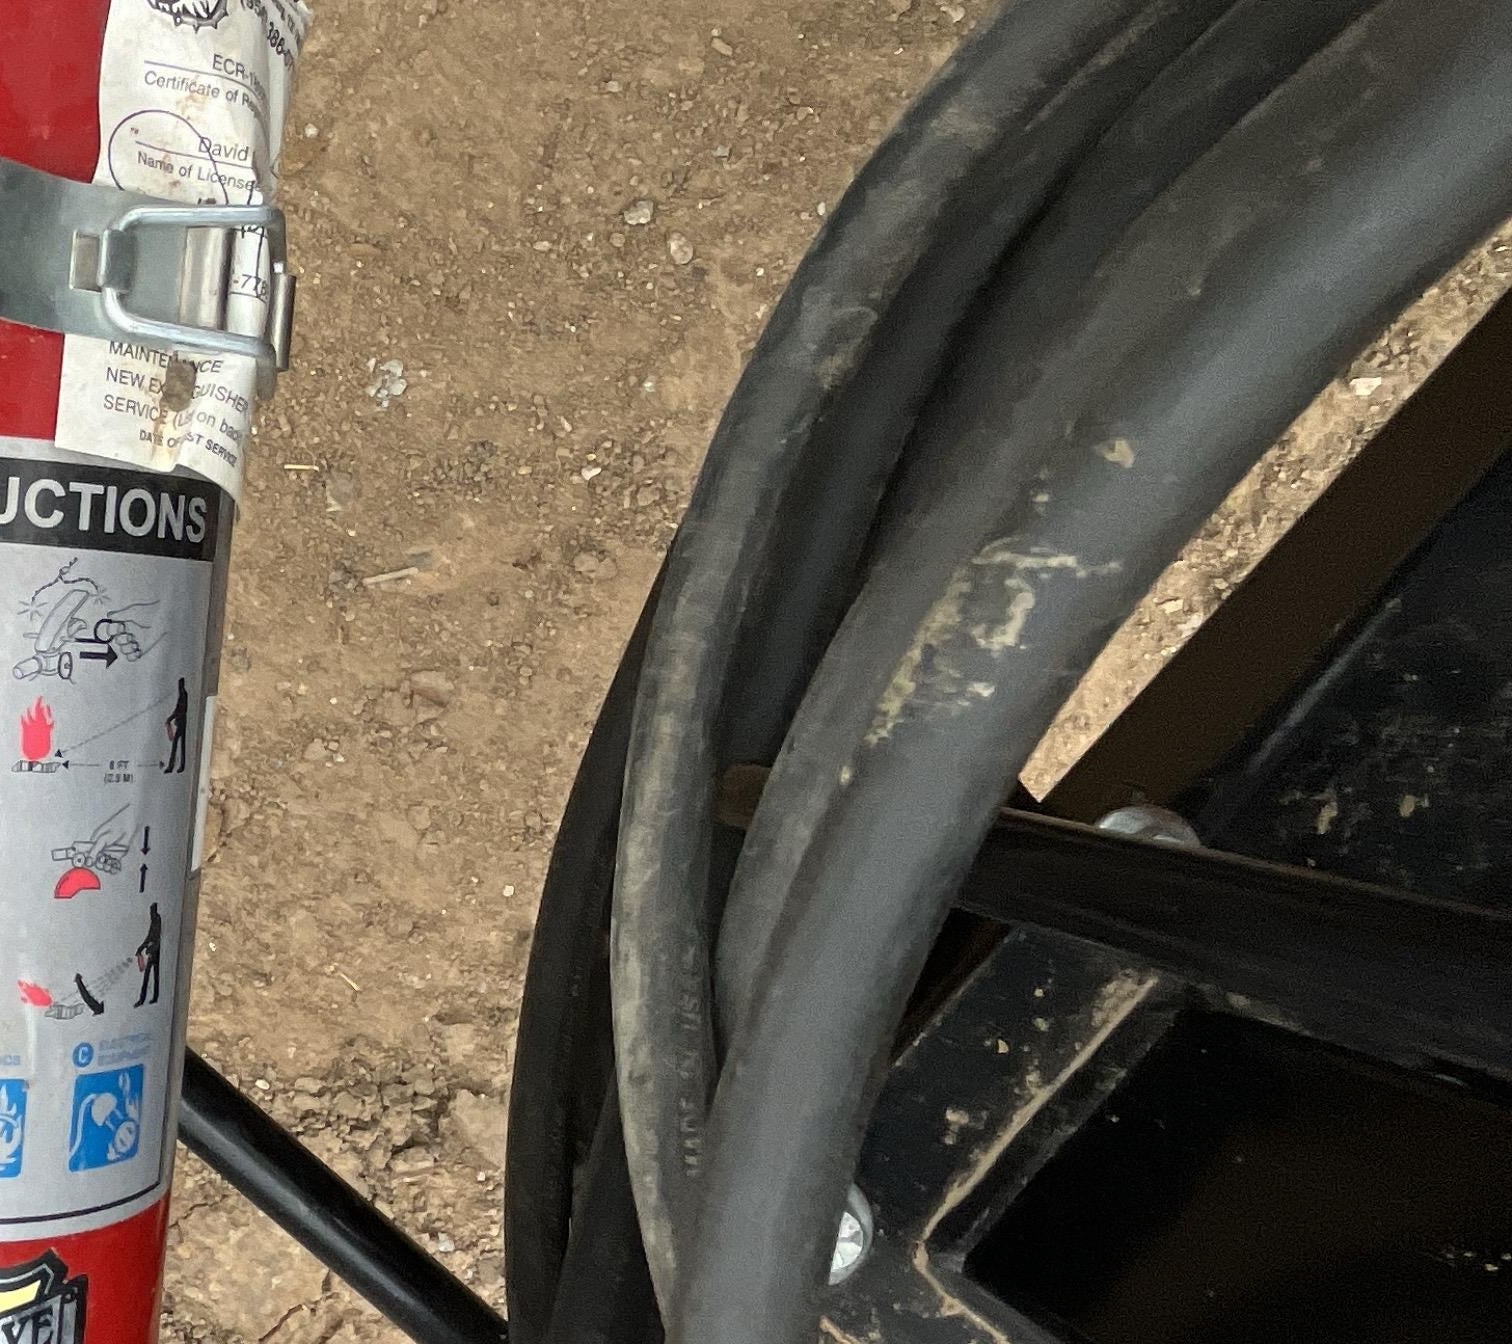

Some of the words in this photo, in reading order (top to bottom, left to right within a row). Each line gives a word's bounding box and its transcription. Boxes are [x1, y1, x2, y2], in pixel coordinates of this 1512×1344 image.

[144, 70, 220, 99] Certificate
[226, 88, 239, 102] of
[197, 136, 250, 162] David
[137, 152, 174, 174] Name
[178, 165, 193, 178] of
[106, 367, 145, 389] NEW
[197, 411, 216, 427] on
